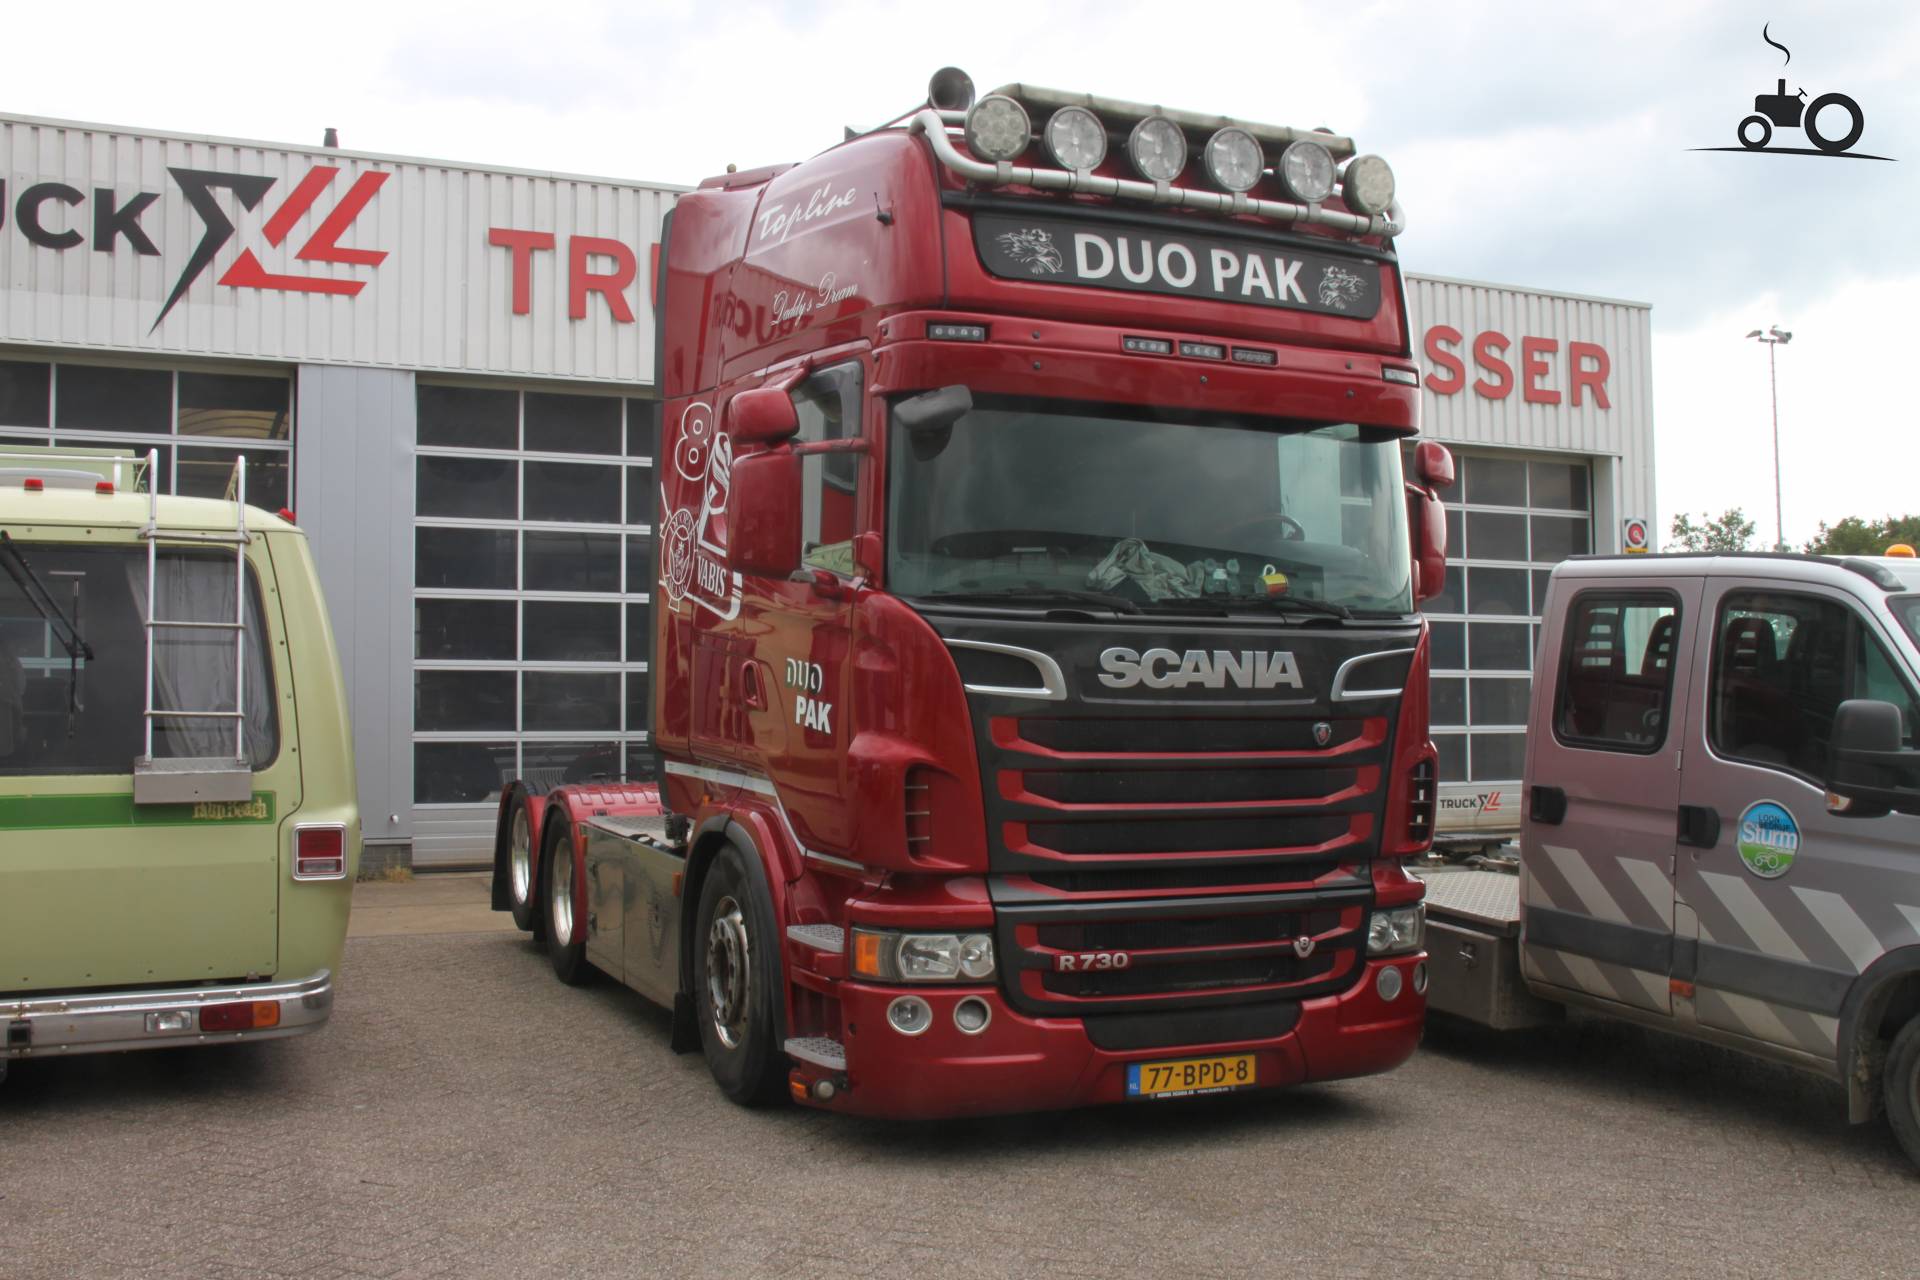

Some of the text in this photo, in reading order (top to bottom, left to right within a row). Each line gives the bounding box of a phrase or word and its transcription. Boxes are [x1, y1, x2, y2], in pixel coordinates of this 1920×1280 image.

[759, 182, 856, 243] Topline
[1074, 232, 1308, 304] DUO PAK
[698, 555, 727, 598] VABIS
[786, 657, 823, 694] DUO
[1098, 647, 1303, 689] SCANIA
[796, 695, 832, 734] PAK
[1440, 799, 1476, 808] TRUCK
[1743, 821, 1797, 848] Sturm
[1059, 952, 1128, 970] R 730
[1149, 1059, 1248, 1089] 77-BPD-8
